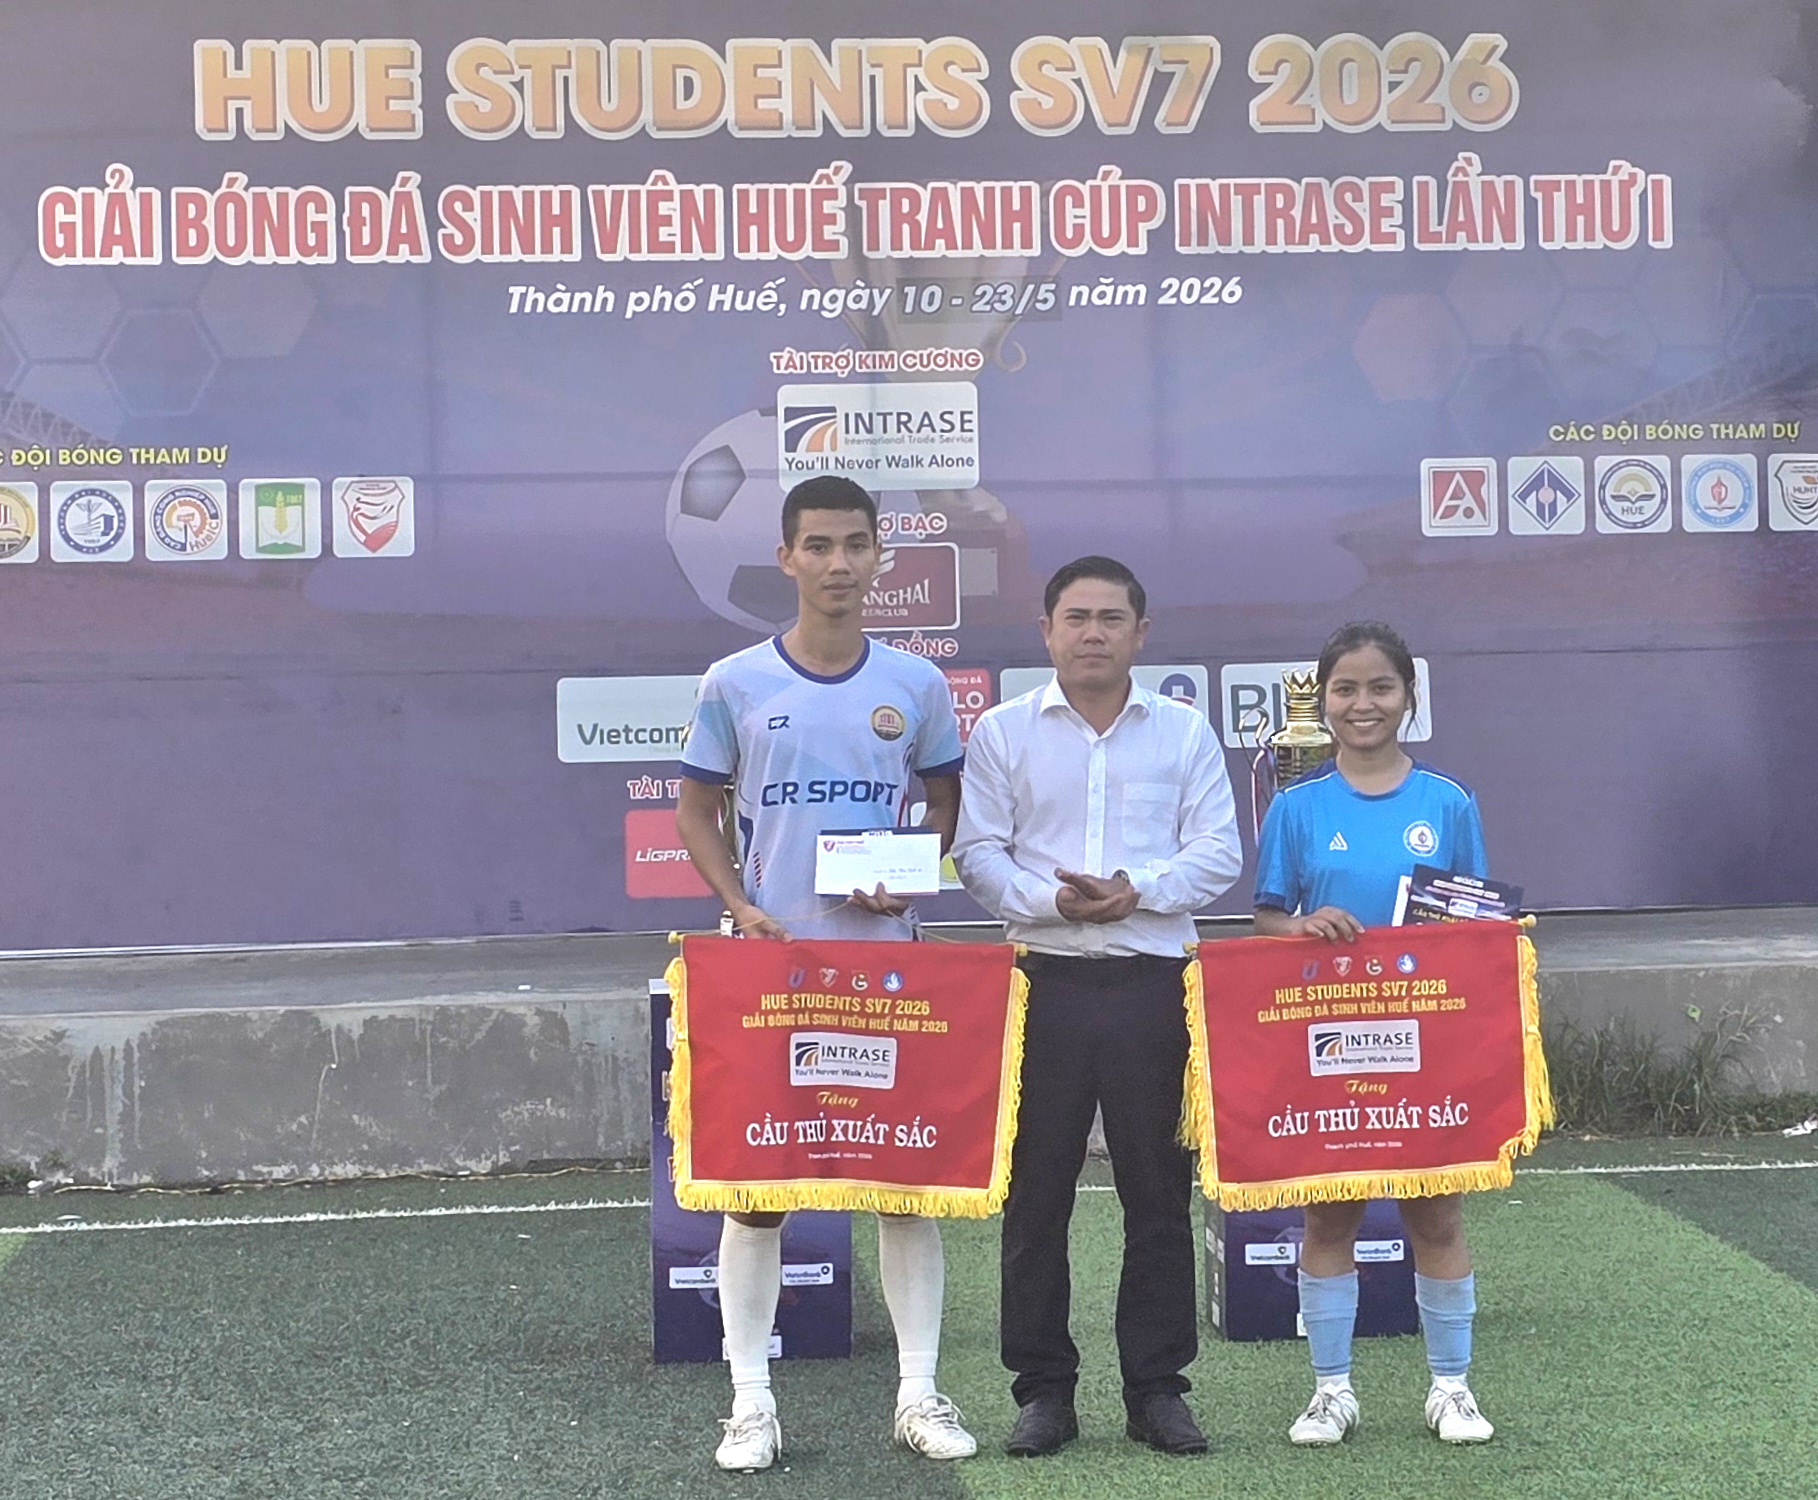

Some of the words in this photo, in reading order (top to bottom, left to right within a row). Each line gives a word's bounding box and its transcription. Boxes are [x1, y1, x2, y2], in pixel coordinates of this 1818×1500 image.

[194, 38, 423, 141] HUE
[446, 37, 989, 140] STUDENTS
[1010, 35, 1220, 136] SV7
[1249, 32, 1520, 133] 2026
[38, 163, 162, 266] GIẢI
[171, 173, 338, 266] BÓNG
[343, 171, 431, 264] ĐÁ
[438, 187, 581, 264] SINH
[588, 170, 727, 263] VIÊN
[734, 162, 853, 262] HUẾ
[855, 180, 1042, 259] TRANH
[1048, 166, 1165, 258] CÚP
[1175, 177, 1406, 254] INTRASE
[1412, 152, 1527, 251] LẦN
[1532, 160, 1649, 251] THỨ
[1648, 173, 1675, 249] I
[508, 283, 615, 314] Thành
[625, 278, 704, 319] phố
[707, 277, 786, 318] Huế,
[800, 279, 892, 319] ngày
[903, 285, 943, 313] 10
[971, 283, 1057, 315] 23/5
[1068, 277, 1147, 307] năm
[1157, 276, 1243, 305] 2026
[770, 347, 807, 374] TÀI
[810, 350, 852, 378] TRỢ
[855, 351, 898, 373] KIM
[900, 348, 984, 373] CƯƠNG
[844, 410, 974, 435] INTRASE
[1549, 421, 1596, 442] CÁC
[1602, 420, 1638, 445] ĐỘI
[1645, 420, 1704, 440] BÓNG
[1709, 423, 1766, 440] THAM
[1773, 421, 1800, 442] DỰ
[844, 436, 905, 446] International
[908, 435, 935, 444] Trade
[939, 434, 974, 444] Service
[11, 444, 51, 471] ĐỘI
[58, 444, 123, 465] BÓNG
[129, 447, 190, 465] THAM
[197, 444, 228, 468] DỰ
[784, 456, 829, 471] You'll
[834, 456, 880, 470] Never
[886, 455, 924, 468] Walk
[928, 454, 975, 468] Alone
[898, 512, 947, 539] BẠC
[953, 691, 984, 709] LO
[627, 775, 662, 800] TÀI
[761, 782, 800, 807] CR
[1275, 987, 1303, 1004] HUE
[1306, 982, 1378, 1001] STUDENTS
[1381, 981, 1408, 997] SV7
[1411, 979, 1447, 996] 2026
[761, 994, 789, 1010] HUE
[792, 993, 861, 1012] STUDENTS
[865, 998, 892, 1014] SV7
[895, 999, 930, 1016] 2026
[1346, 1032, 1413, 1046] INTRASE
[821, 1045, 890, 1062] INTRASE
[1268, 1104, 1309, 1138] CẦU
[1314, 1100, 1359, 1133] THỦ
[1365, 1097, 1422, 1129] XUẤT
[1428, 1095, 1469, 1128] SẮC
[746, 1112, 788, 1146] CẦU
[794, 1112, 827, 1143] THỦ
[830, 1114, 889, 1144] XUẤT
[894, 1115, 937, 1148] SẮC
